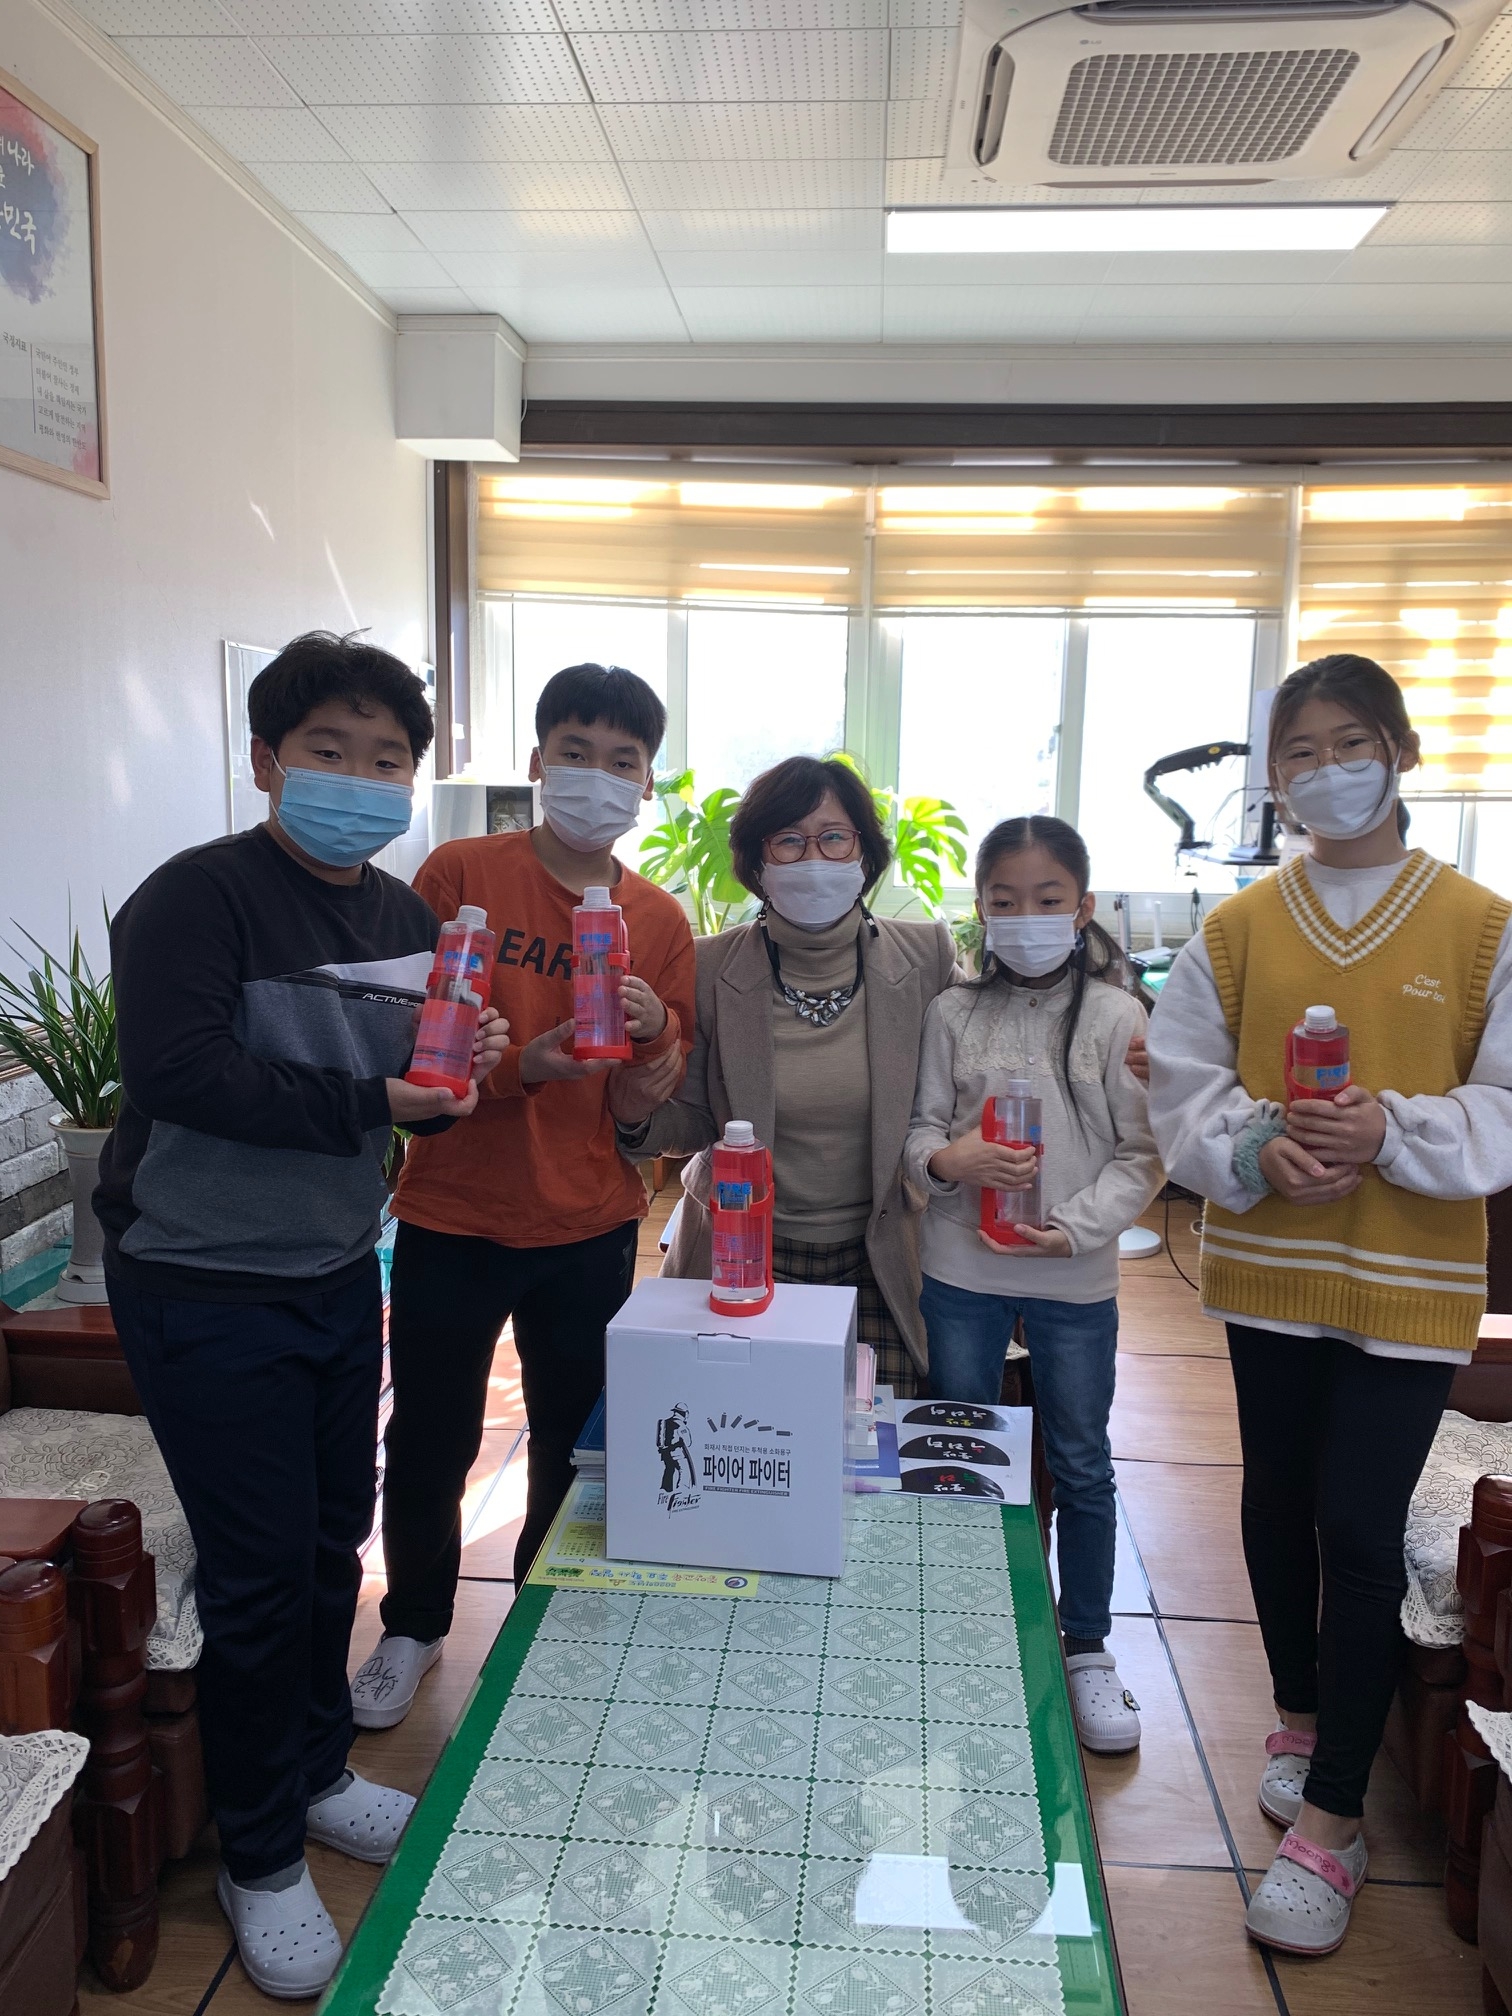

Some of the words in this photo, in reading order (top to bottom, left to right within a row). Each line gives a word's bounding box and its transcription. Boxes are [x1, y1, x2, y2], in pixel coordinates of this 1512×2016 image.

[0, 201, 37, 255] 민국
[1415, 973, 1442, 989] C'est
[1402, 984, 1433, 998] Pour
[362, 993, 408, 1006] ACTIVE
[733, 1445, 750, 1453] 던지는
[703, 1454, 744, 1485] 파이어
[748, 1457, 791, 1488] 파이터
